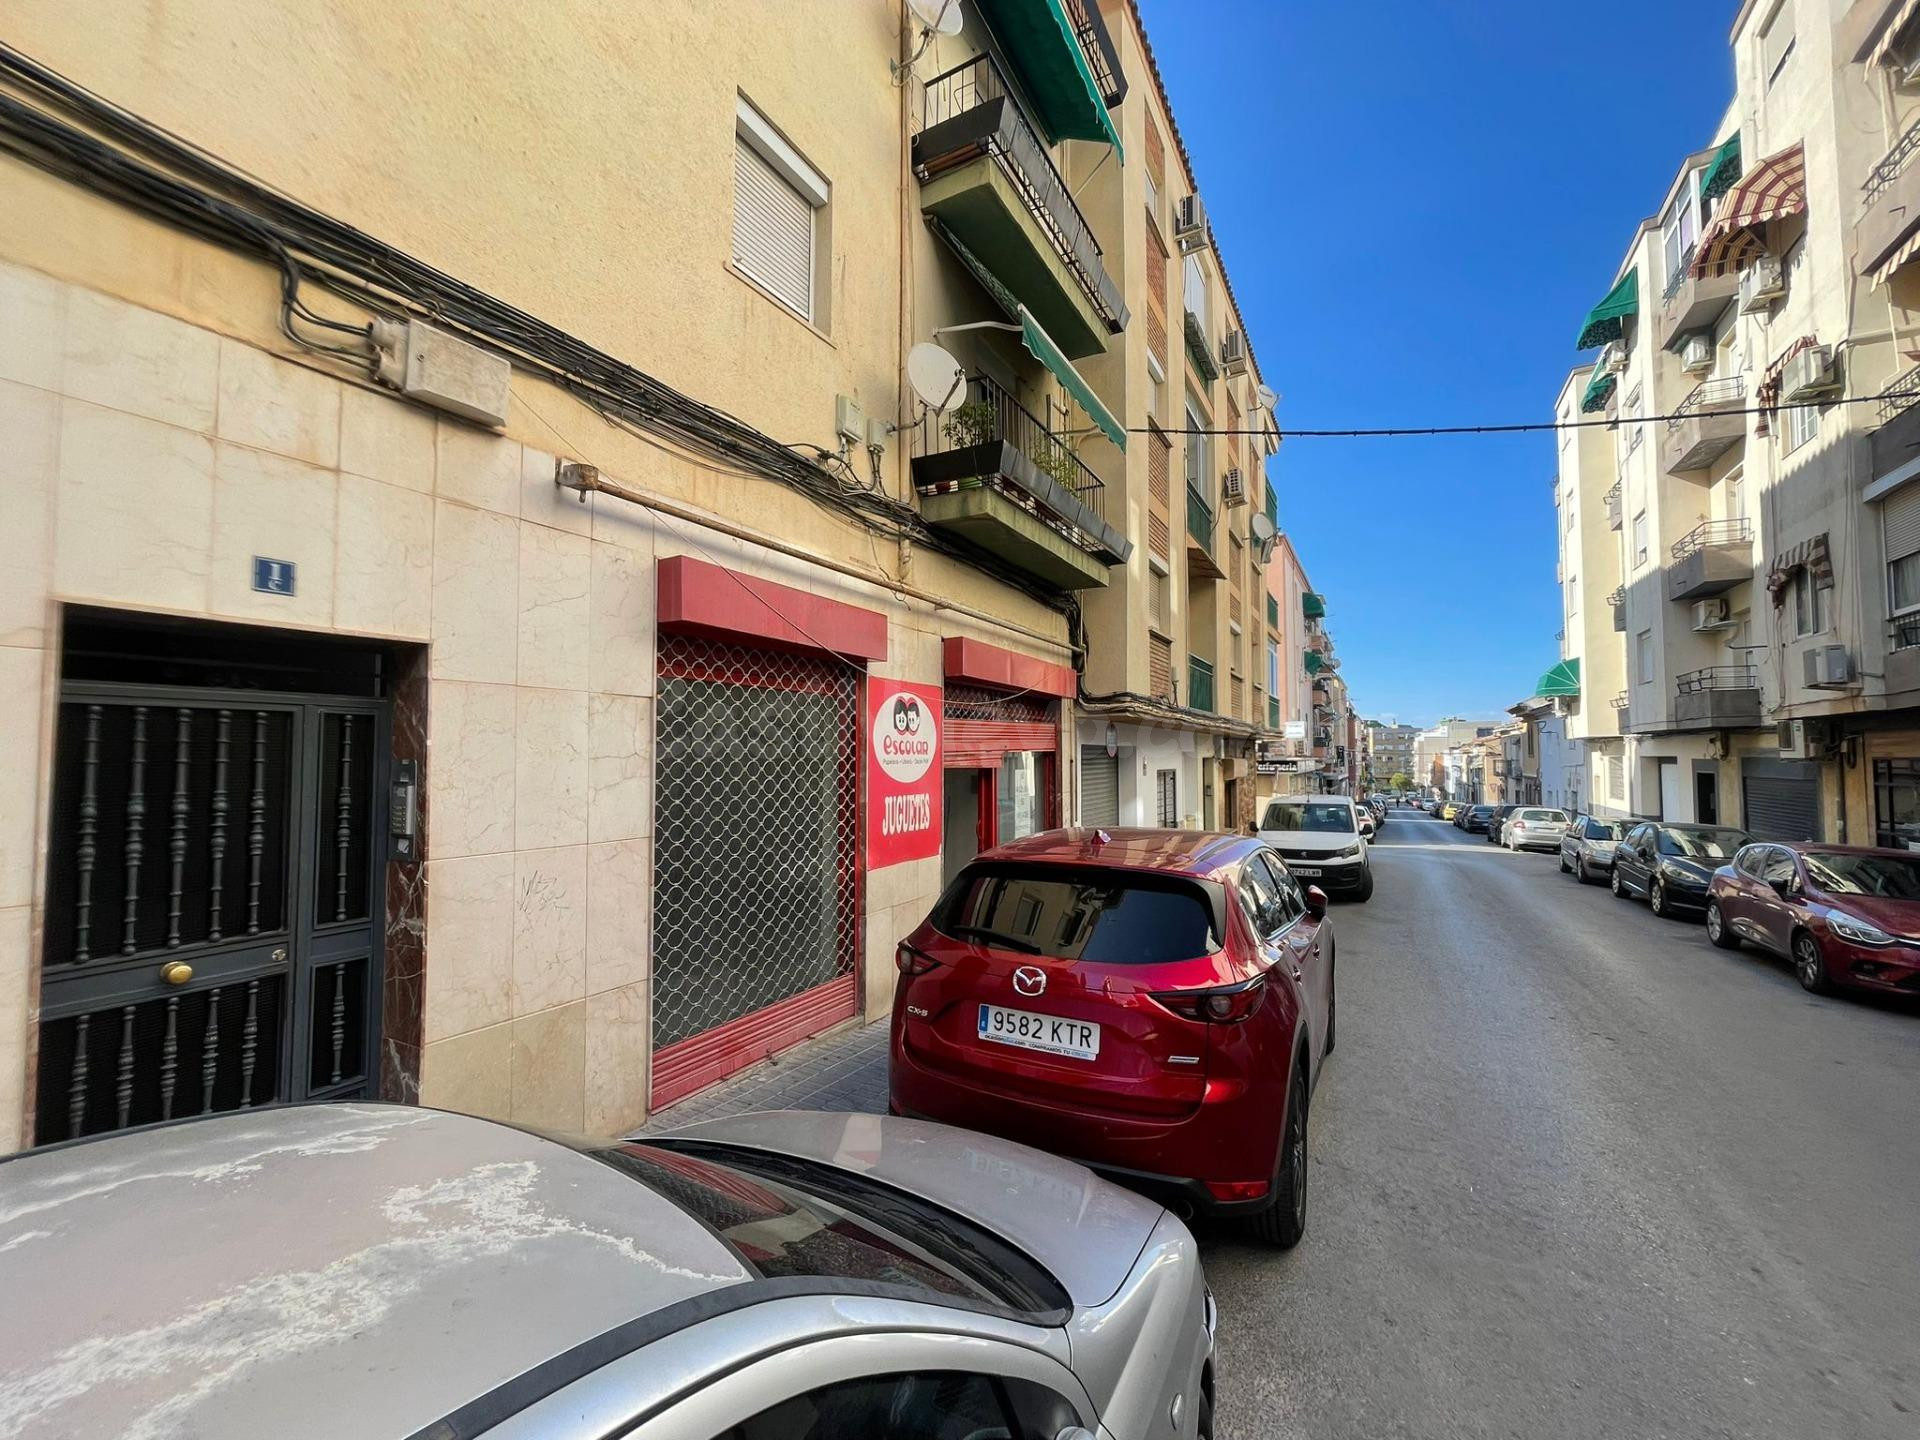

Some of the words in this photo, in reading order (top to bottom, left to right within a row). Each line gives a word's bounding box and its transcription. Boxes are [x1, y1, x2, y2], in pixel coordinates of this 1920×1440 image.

[882, 793, 931, 836] JUGUETES
[907, 1005, 928, 1016] CX-5
[993, 1011, 1043, 1039] 9582
[1051, 1020, 1092, 1048] KTR
